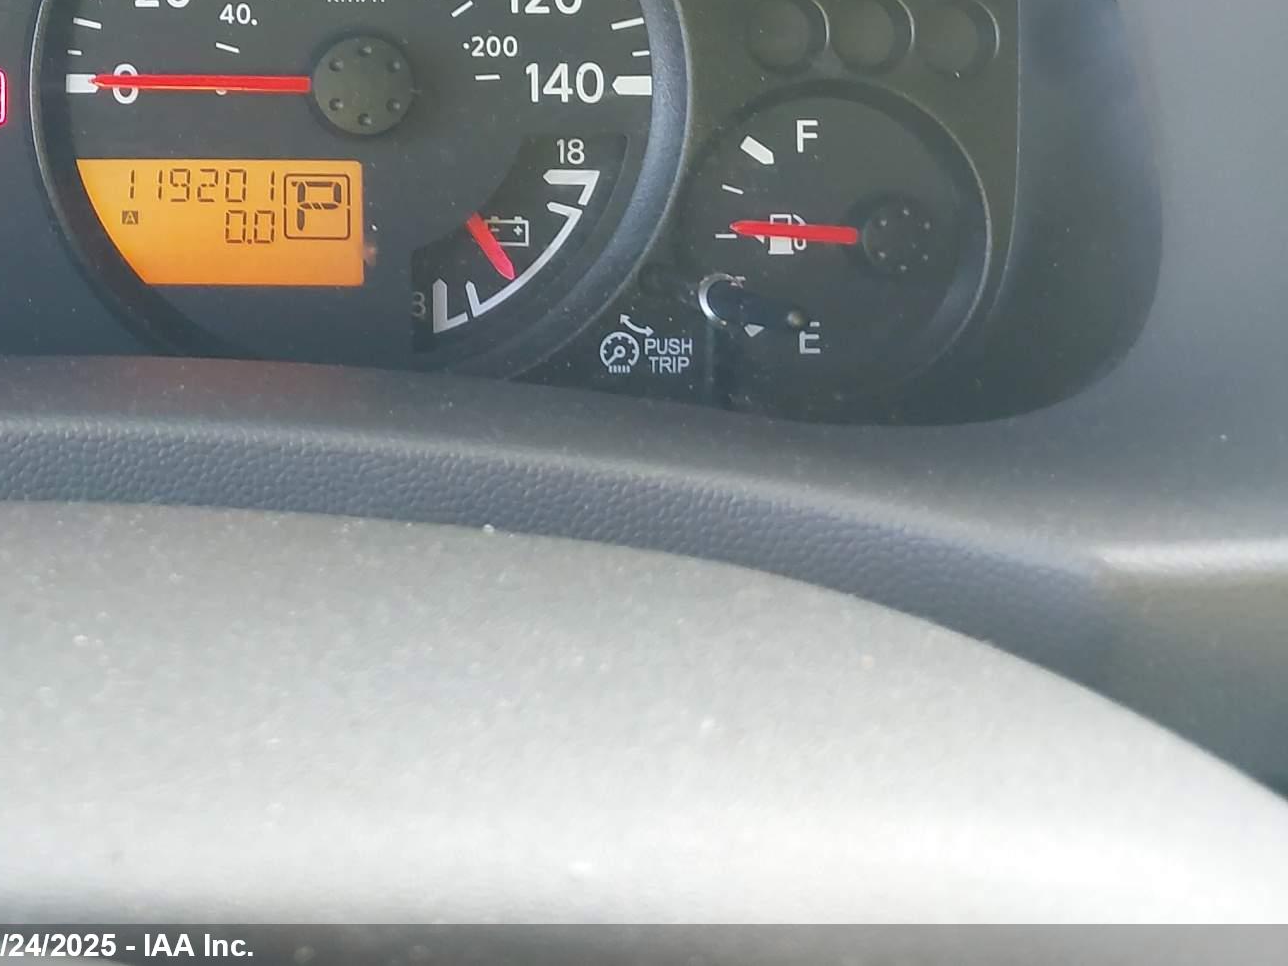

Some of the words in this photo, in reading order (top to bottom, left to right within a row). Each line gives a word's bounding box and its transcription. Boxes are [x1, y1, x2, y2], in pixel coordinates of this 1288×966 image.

[471, 36, 518, 58] 200
[112, 64, 139, 104] 0
[525, 63, 604, 103] 140
[556, 139, 585, 165] 18
[797, 120, 818, 152] F
[130, 168, 275, 203] 119201
[291, 181, 342, 231] P
[225, 210, 275, 244] 0.0
[644, 338, 693, 355] PUSH
[649, 356, 690, 373] TRIP
